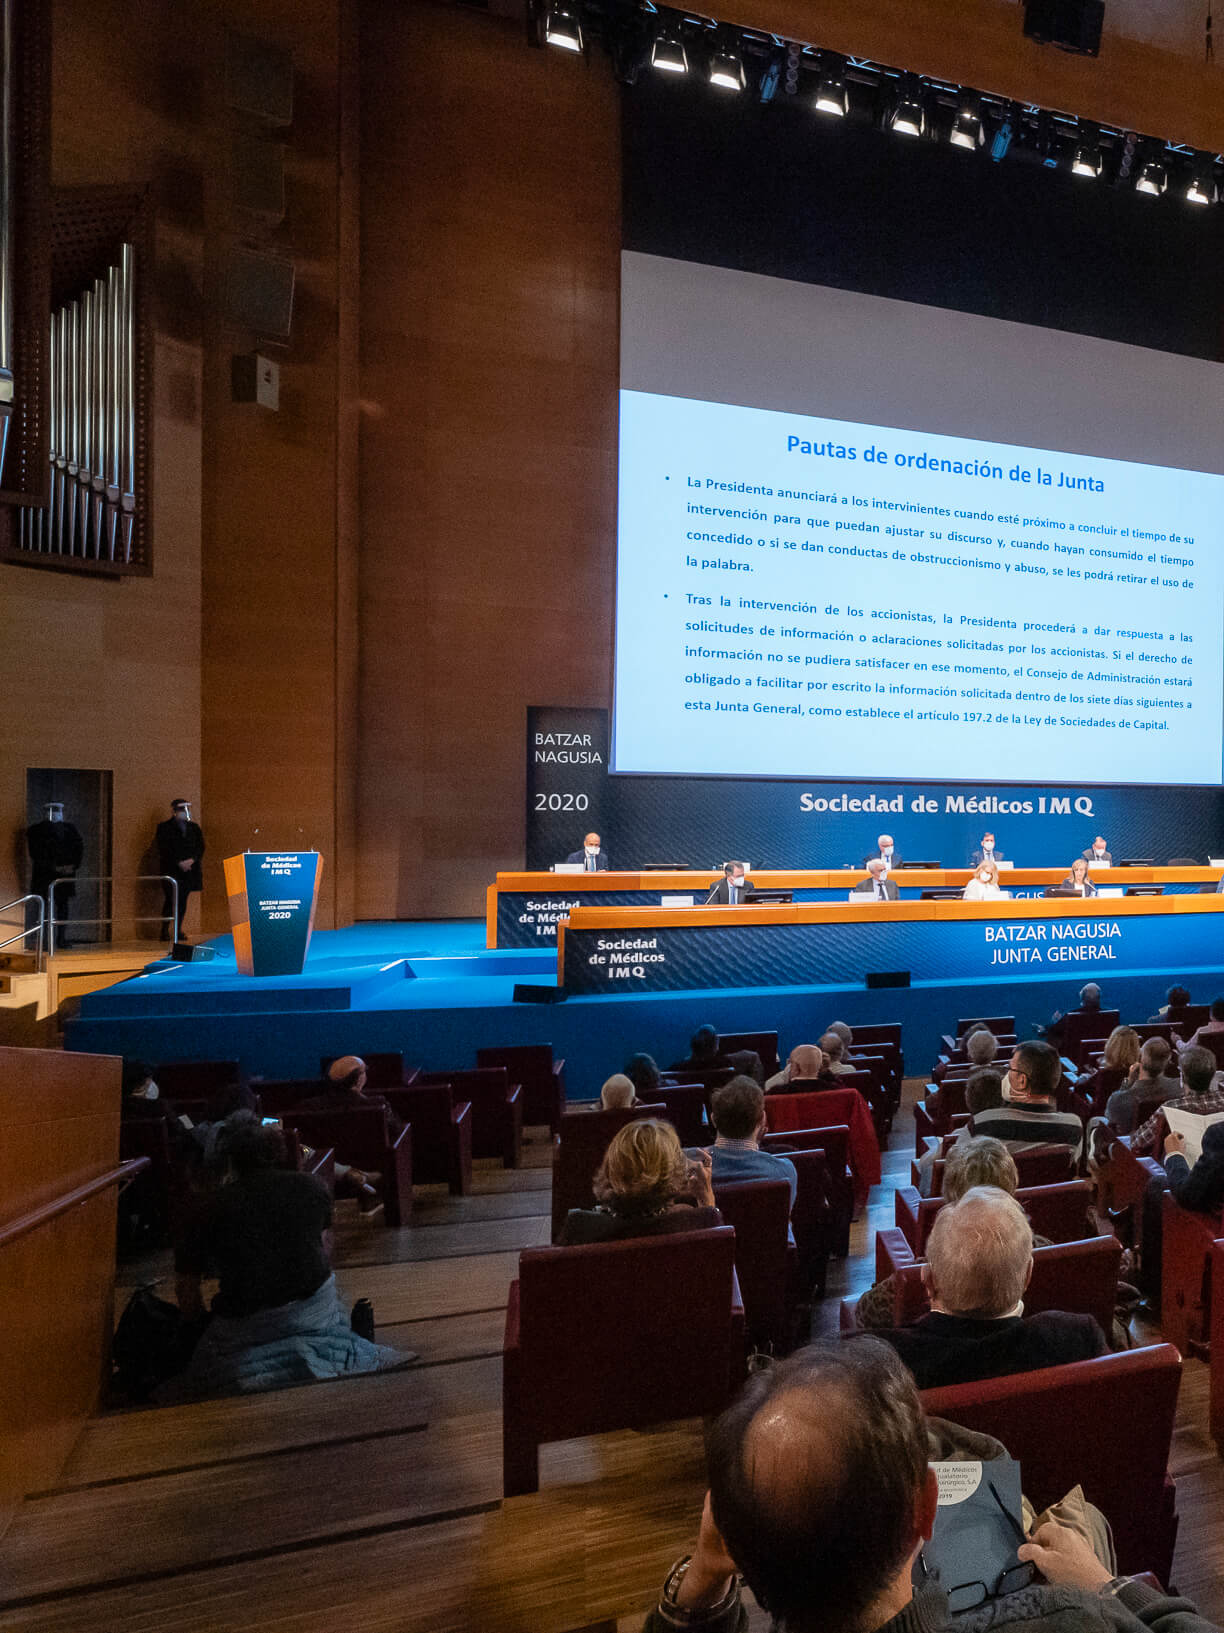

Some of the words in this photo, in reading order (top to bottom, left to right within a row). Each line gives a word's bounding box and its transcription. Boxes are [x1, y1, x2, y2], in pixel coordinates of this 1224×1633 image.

[788, 436, 856, 460] Pautas
[864, 445, 888, 464] de
[894, 452, 1002, 480] ordenación
[1009, 464, 1031, 483] de
[1038, 468, 1052, 486] la
[1057, 472, 1104, 492] Junta
[688, 476, 701, 488] La
[706, 478, 773, 496] Presidenta
[778, 490, 838, 503] anunciará
[852, 496, 868, 507] los
[872, 496, 950, 516] intervinientes
[954, 510, 994, 522] cuando
[998, 514, 1020, 524] esté
[1023, 517, 1066, 530] próximo
[1068, 523, 1075, 531] a
[1078, 525, 1118, 536] concluir
[1120, 528, 1129, 536] el
[1132, 528, 1166, 542] tiempo
[1169, 533, 1181, 543] de
[688, 502, 767, 520] intervención
[774, 514, 800, 527] para
[807, 518, 830, 528] que
[836, 521, 879, 533] puedan
[885, 524, 925, 538] ajustar
[930, 532, 942, 540] su
[948, 531, 992, 544] discurso
[998, 539, 1006, 548] y,
[1010, 540, 1050, 551] cuando
[1054, 542, 1084, 556] hayan
[1089, 549, 1143, 560] consumido
[1148, 553, 1156, 562] el
[1160, 554, 1194, 568] tiempo
[686, 532, 752, 546] concedido
[770, 538, 779, 548] si
[784, 542, 797, 550] se
[801, 540, 823, 552] dan
[828, 546, 888, 558] conductas
[892, 550, 906, 560] de
[910, 552, 1001, 570] obstruccionismo
[1004, 563, 1010, 573] y
[1014, 562, 1048, 576] abuso,
[1052, 568, 1063, 576] se
[1067, 568, 1081, 578] les
[1084, 570, 1113, 581] podrá
[1117, 574, 1148, 584] retirar
[1150, 576, 1158, 585] el
[1163, 579, 1179, 587] uso
[1182, 579, 1194, 589] de
[686, 555, 697, 567] la
[702, 558, 754, 572] palabra.
[685, 594, 712, 605] Tras
[720, 595, 731, 607] la
[739, 597, 816, 614] intervención
[825, 604, 839, 615] de
[848, 606, 864, 616] los
[870, 609, 936, 624] accionistas,
[944, 613, 952, 624] la
[960, 616, 1016, 628] Presidenta
[1024, 623, 1076, 633] procederá
[1094, 626, 1110, 636] dar
[1116, 630, 1164, 640] respuesta
[1181, 632, 1192, 642] las
[685, 620, 754, 634] solicitudes
[760, 625, 775, 636] de
[781, 626, 854, 642] información
[872, 634, 942, 647] aclaraciones
[947, 640, 1004, 651] solicitadas
[1008, 646, 1027, 654] por
[1032, 644, 1046, 655] los
[1050, 647, 1108, 659] accionistas.
[1113, 650, 1121, 660] Si
[1126, 651, 1134, 660] el
[1138, 652, 1177, 664] derecho
[1181, 656, 1192, 664] de
[685, 646, 762, 661] información
[768, 654, 783, 662] no
[788, 656, 800, 664] se
[805, 654, 850, 666] pudiera
[855, 658, 910, 670] satisfacer
[931, 664, 950, 672] ese
[954, 665, 1010, 677] momento,
[1014, 666, 1022, 676] el
[1026, 668, 1068, 680] Consejo
[1071, 670, 1084, 680] de
[1086, 672, 1160, 684] Administración
[1164, 677, 1192, 686] estará
[685, 673, 740, 686] obligado
[745, 678, 752, 686] a
[756, 676, 804, 688] facilitar
[808, 682, 828, 691] por
[832, 680, 871, 692] escrito
[876, 682, 885, 693] la
[889, 683, 957, 696] información
[961, 688, 1012, 700] solicitada
[1016, 690, 1050, 702] dentro
[1054, 692, 1066, 702] de
[1070, 693, 1084, 703] los
[1087, 694, 1110, 704] siete
[1136, 696, 1184, 708] siguientes
[684, 701, 712, 710] esta
[714, 701, 749, 712] Junta
[753, 702, 804, 716] General,
[808, 708, 842, 716] como
[845, 708, 900, 718] establece
[904, 709, 914, 719] el
[963, 712, 992, 722] 197.2
[996, 713, 1008, 723] de
[1012, 713, 1021, 724] la
[1024, 715, 1042, 726] Ley
[1044, 715, 1056, 726] de
[1060, 716, 1116, 728] Sociedades
[1118, 719, 1131, 728] de
[1133, 720, 1169, 731] Capital.
[535, 733, 592, 746] BATZAR
[535, 751, 602, 764] NAGUSIA
[535, 793, 589, 811] 2020
[800, 793, 904, 812] Sociedad
[911, 795, 938, 813] de
[945, 796, 1034, 814] Médicos
[526, 901, 580, 911] Sociedad
[519, 914, 534, 923] de
[536, 926, 557, 935] IM
[985, 925, 1047, 942] BATZAR
[1051, 923, 1121, 939] NAGUSIA
[597, 938, 657, 950] Sociedad
[991, 948, 1042, 965] JUNTA
[1047, 944, 1117, 962] GENERAL
[589, 954, 606, 965] de
[609, 952, 665, 964] Médicos
